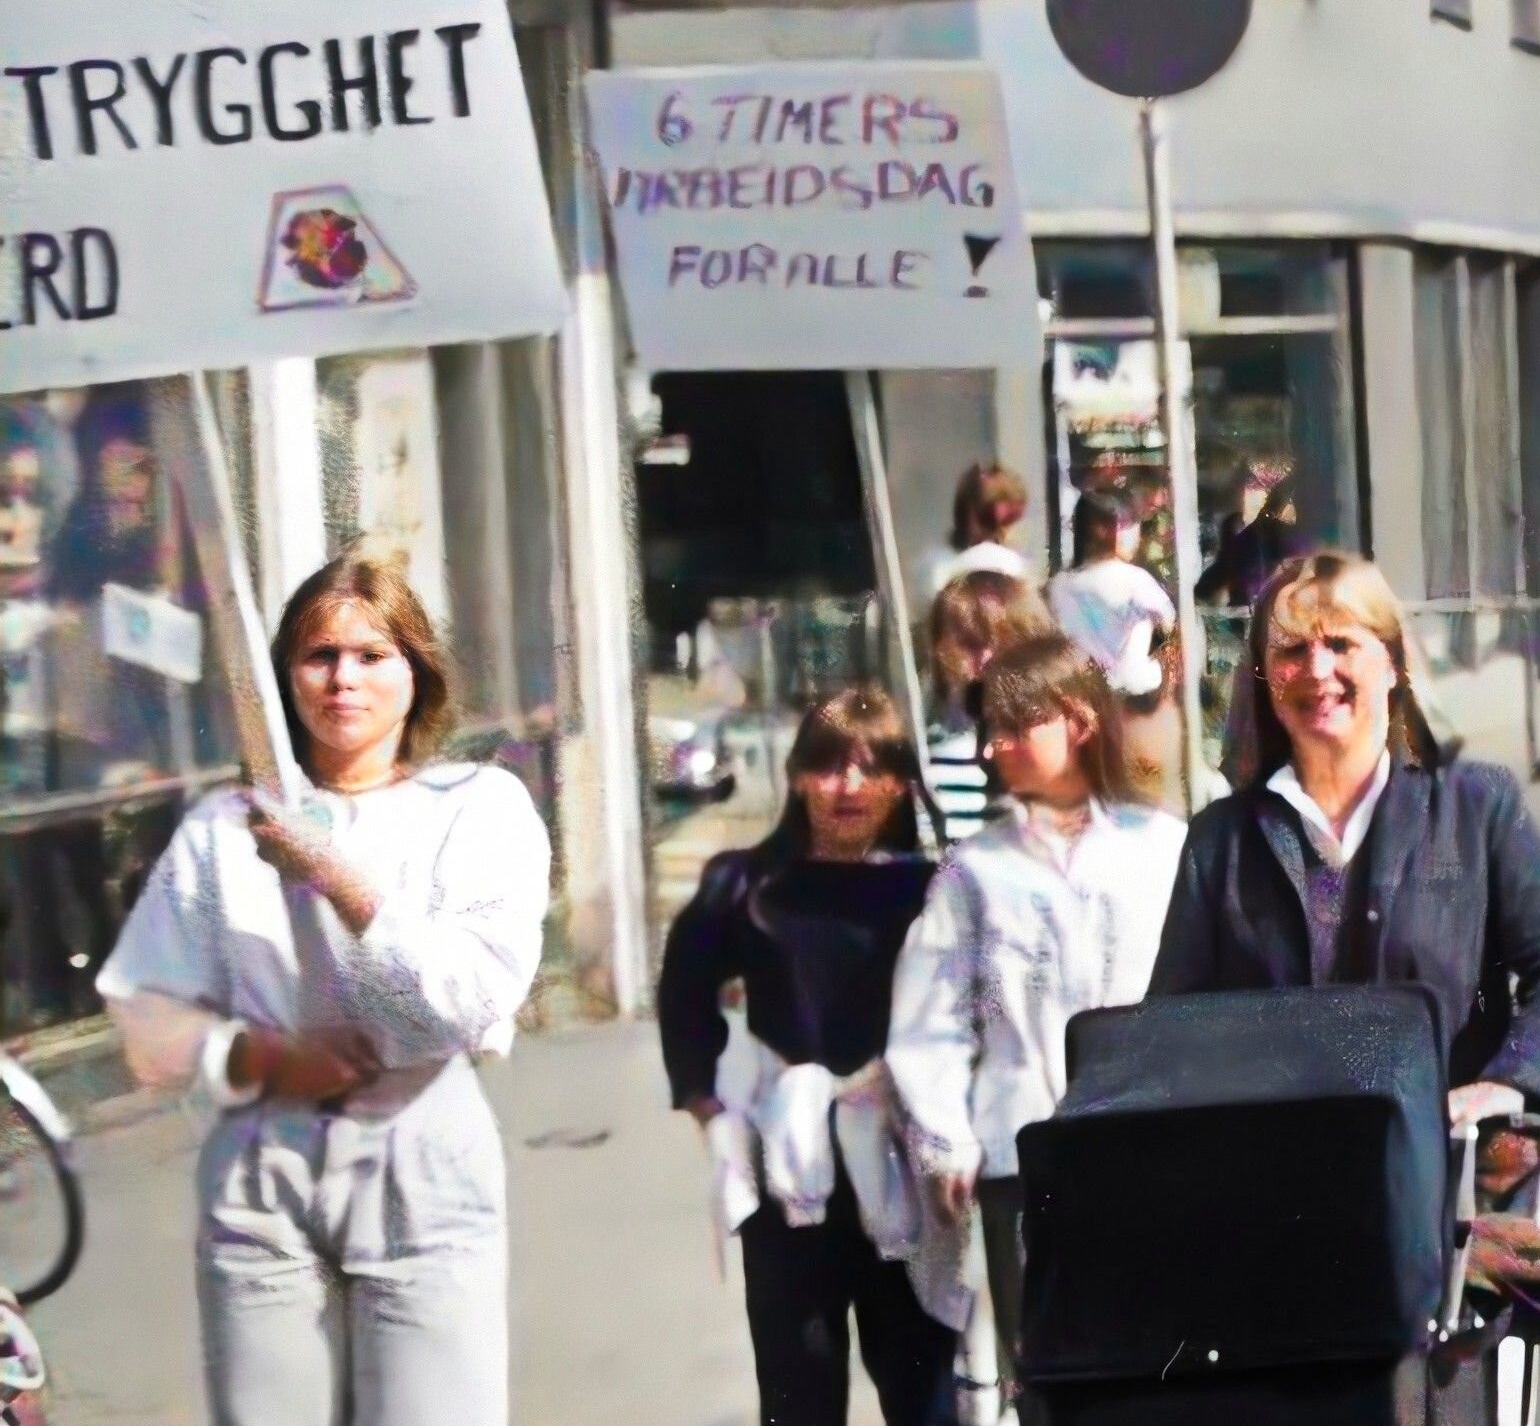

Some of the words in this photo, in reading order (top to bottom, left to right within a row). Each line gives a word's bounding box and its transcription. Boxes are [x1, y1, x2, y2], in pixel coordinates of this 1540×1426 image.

[4, 22, 482, 161] TRYGGHET
[657, 90, 693, 147] 6
[711, 91, 960, 146] TIMERS
[0, 226, 120, 330] RD
